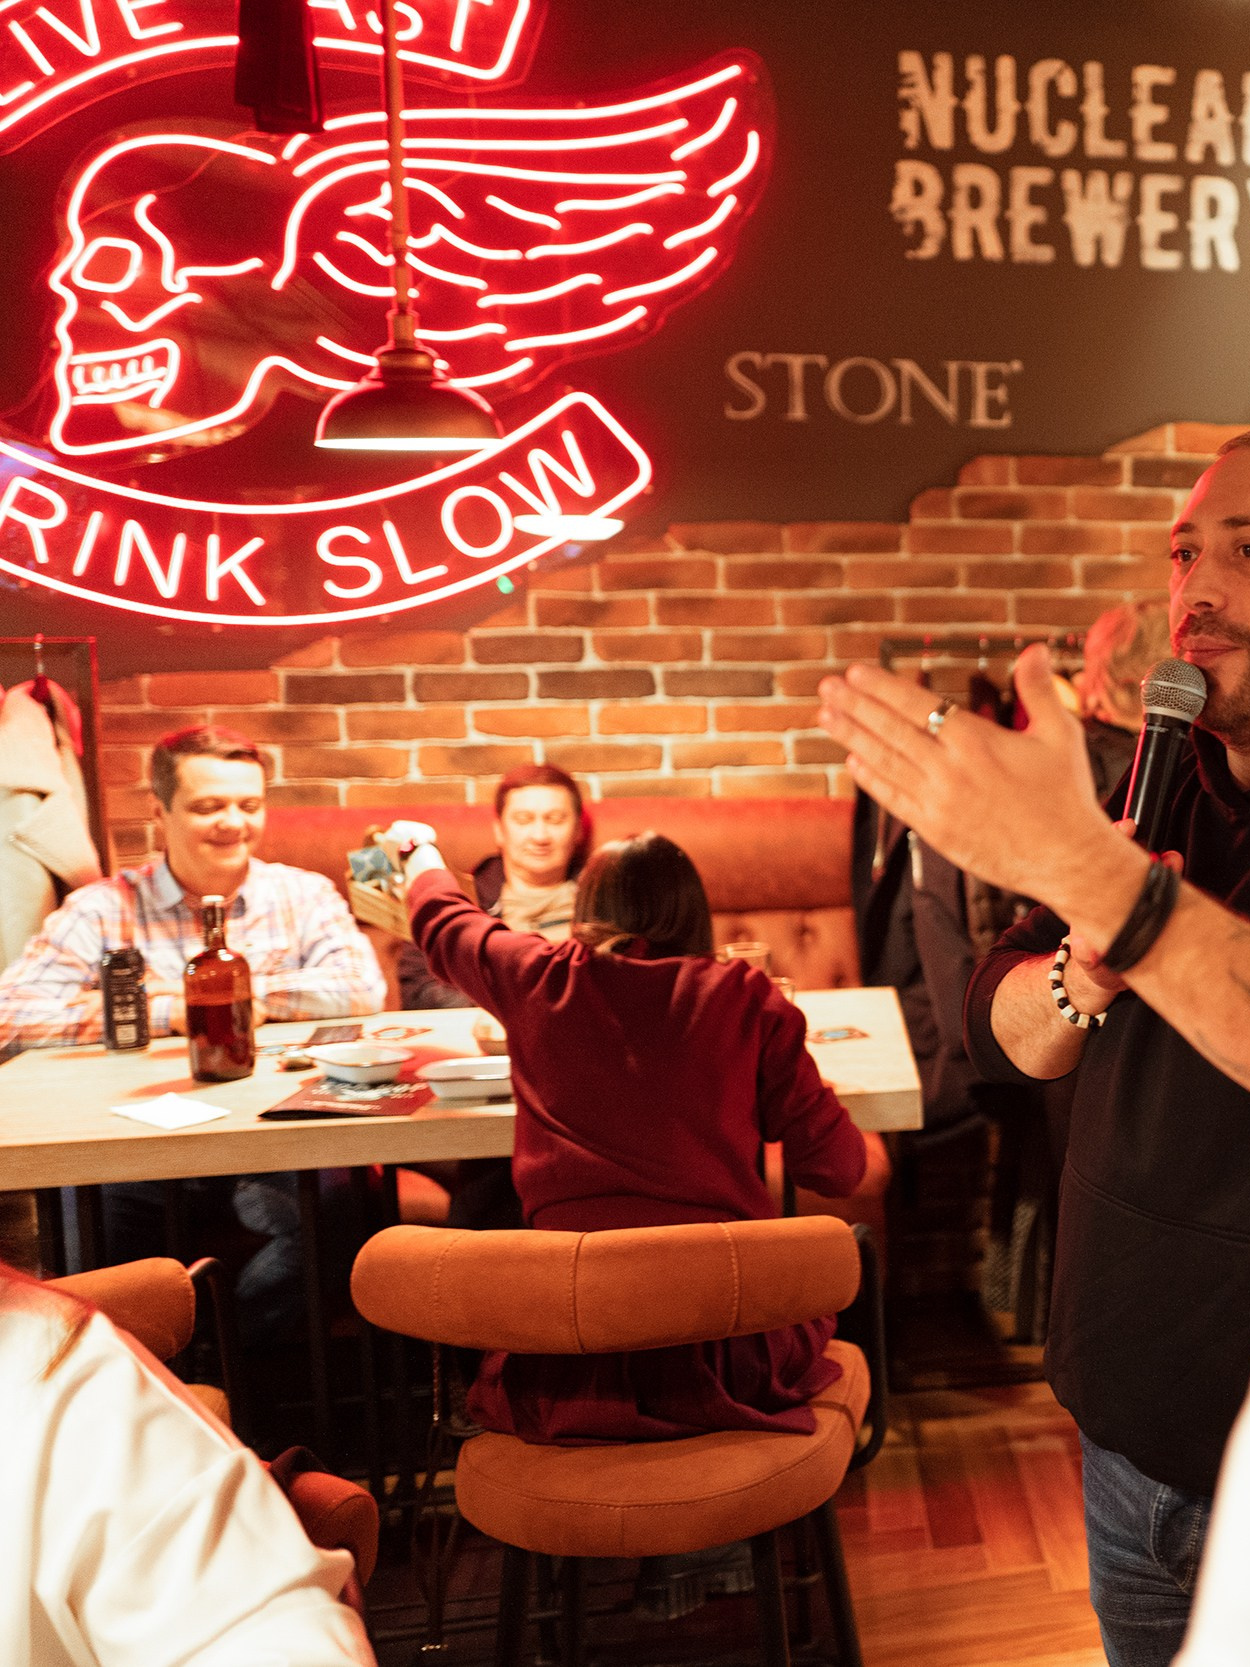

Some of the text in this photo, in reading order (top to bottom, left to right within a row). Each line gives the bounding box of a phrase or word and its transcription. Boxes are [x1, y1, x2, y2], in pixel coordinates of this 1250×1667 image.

[0, 0, 184, 101] IVE
[723, 349, 1023, 430] STONE
[315, 429, 596, 600] SLOW
